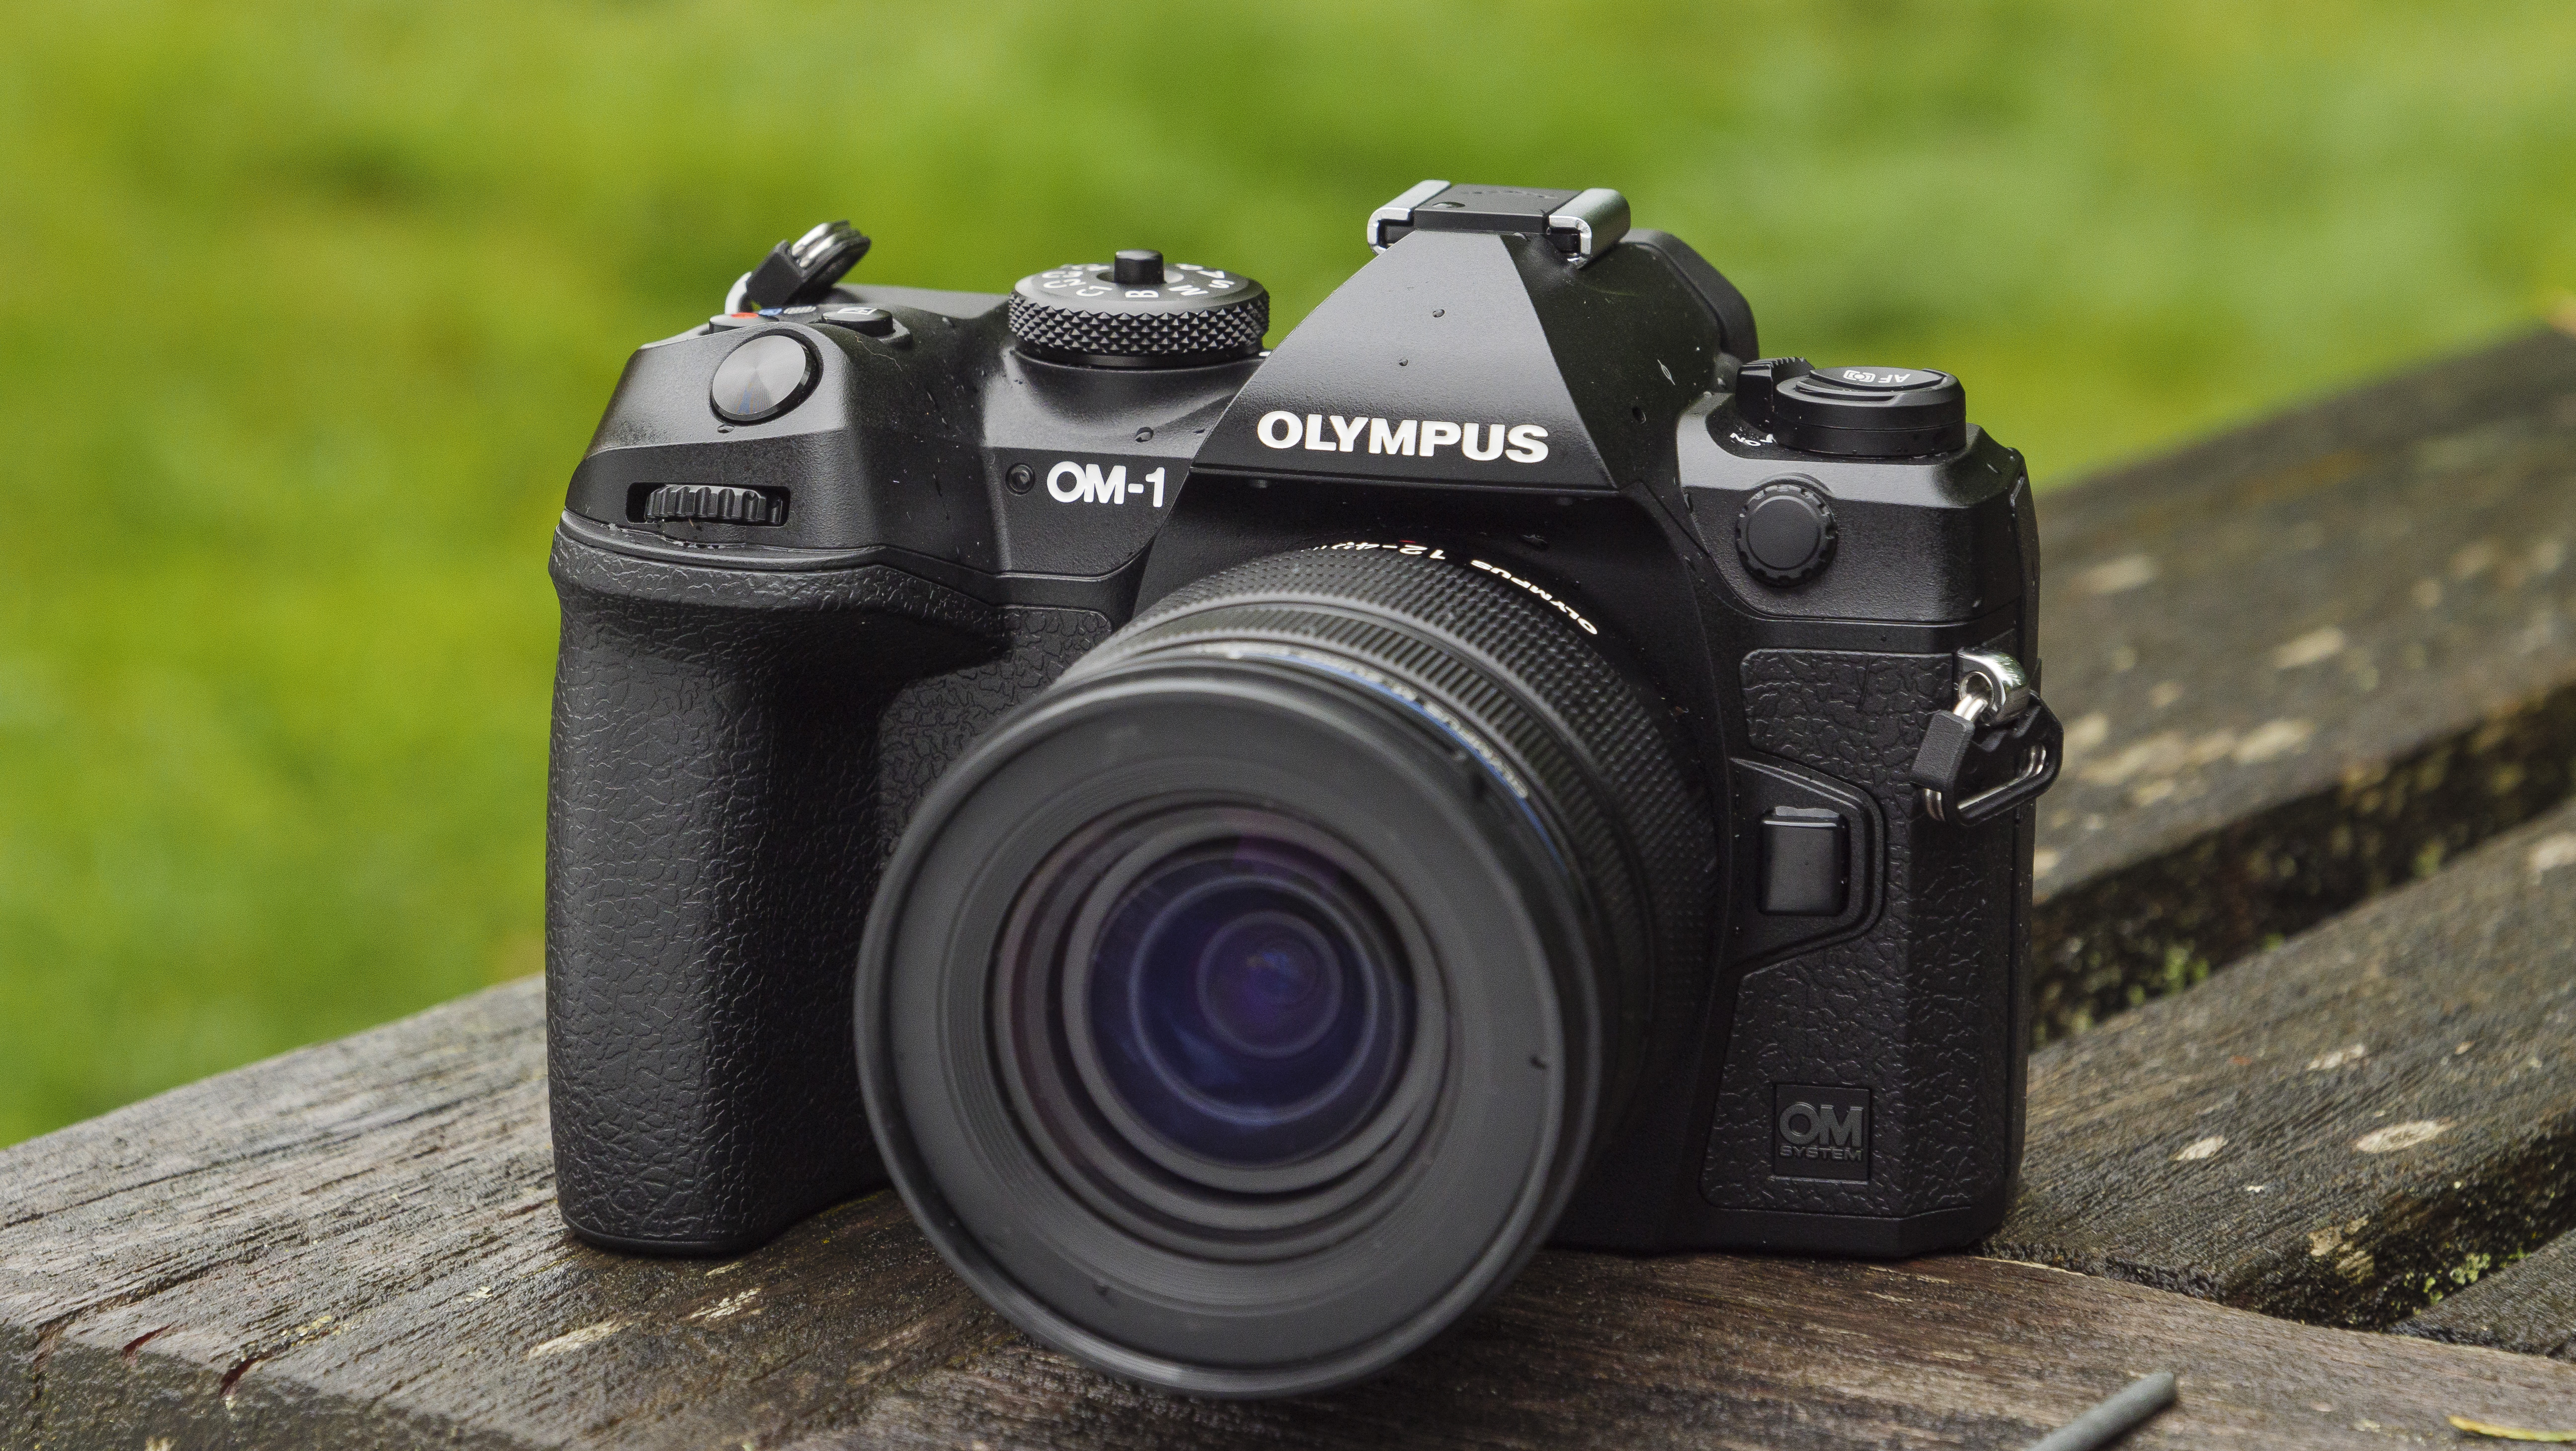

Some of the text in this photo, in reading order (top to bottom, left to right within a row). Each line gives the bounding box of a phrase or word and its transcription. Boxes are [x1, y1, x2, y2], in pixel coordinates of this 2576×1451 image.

[1043, 278, 1087, 289] C2
[1168, 284, 1209, 296] M
[1208, 279, 1235, 289] S
[1075, 285, 1113, 297] C1
[1125, 290, 1159, 298] B
[1877, 373, 1911, 384] AF
[1257, 410, 1550, 463] OLYMPUS
[1729, 432, 1762, 447] ON
[1046, 461, 1166, 508] OM-1
[1470, 559, 1598, 635] OLYMPUS
[1779, 1102, 1864, 1147] OM
[1779, 1144, 1863, 1162] SYSTEM
